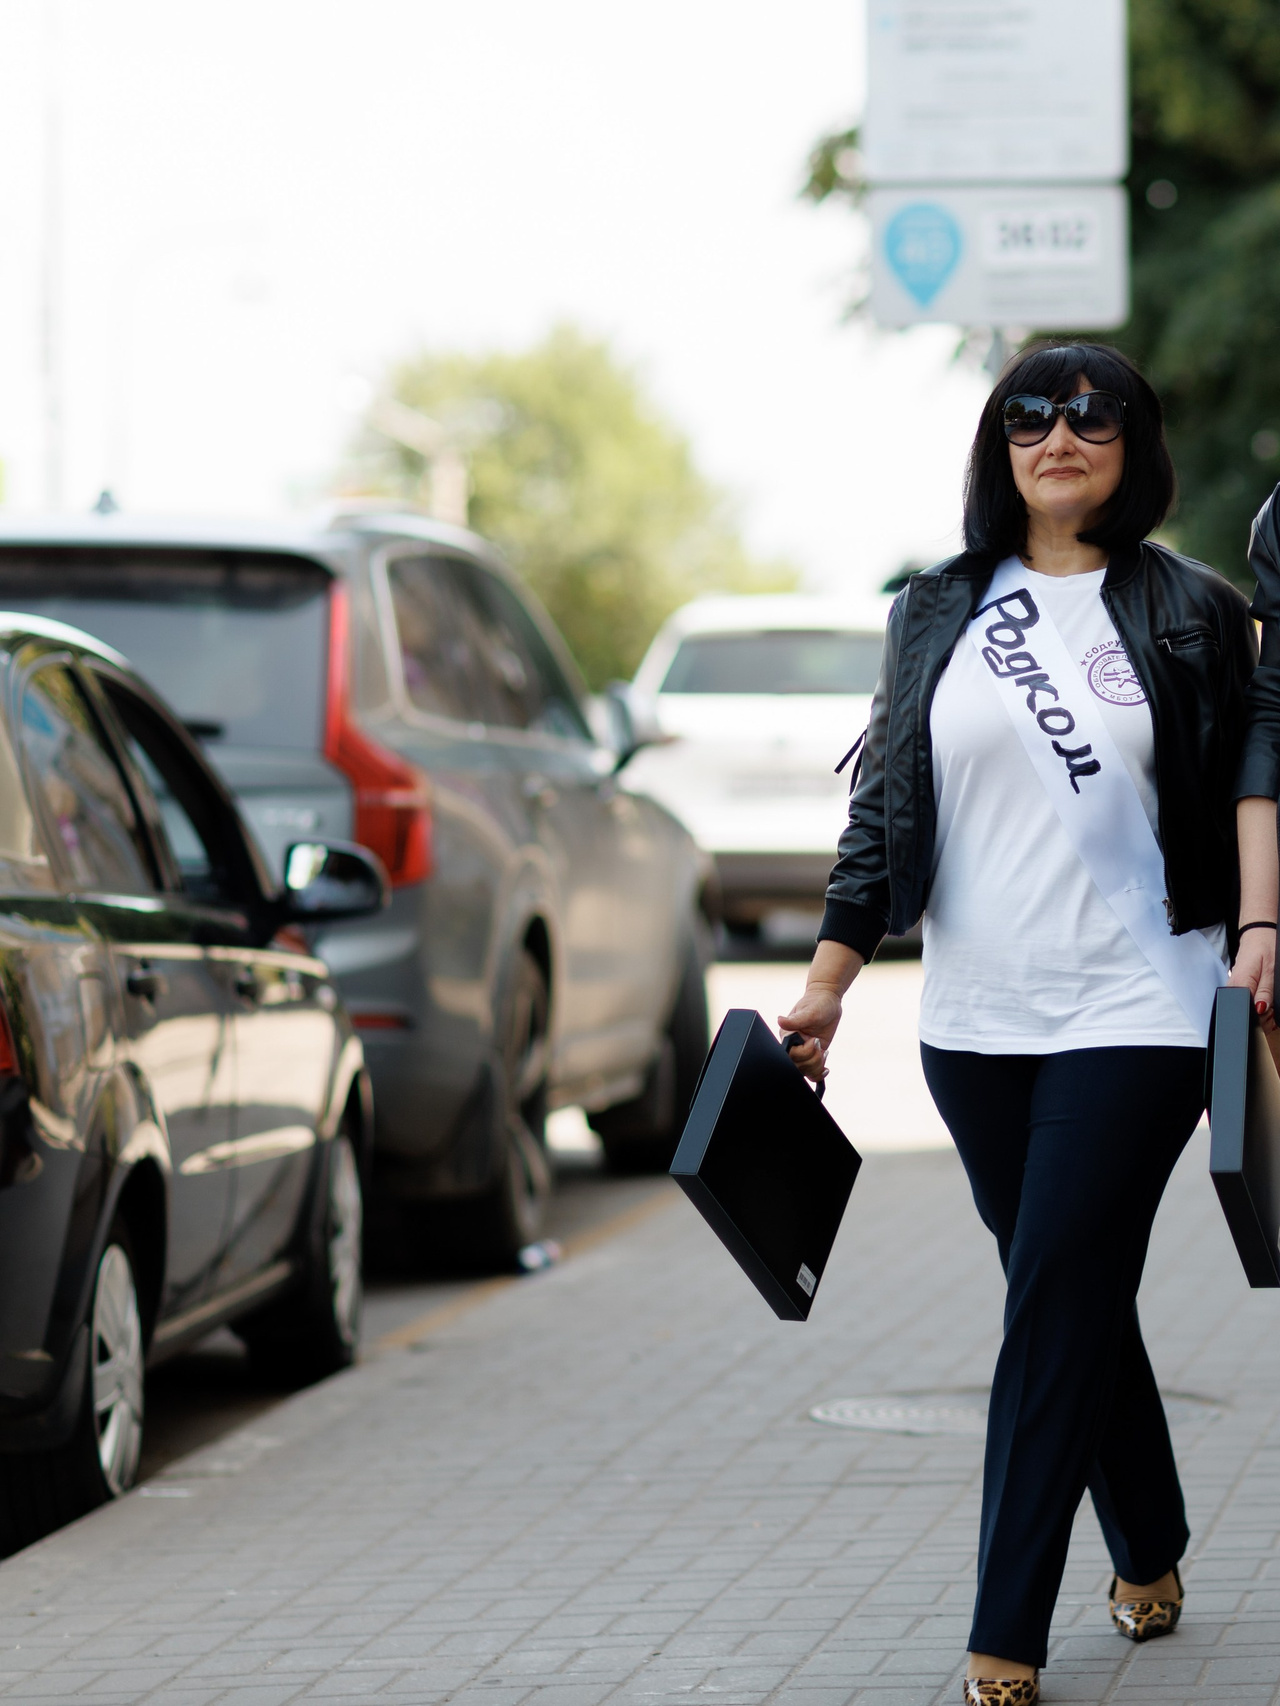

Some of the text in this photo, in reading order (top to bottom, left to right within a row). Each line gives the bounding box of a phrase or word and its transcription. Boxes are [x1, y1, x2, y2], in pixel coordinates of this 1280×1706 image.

[1085, 639, 1124, 658] СОДРУ
[1092, 654, 1128, 688] ОБРАЗОВАТЕЛ
[972, 587, 1102, 795] Родком
